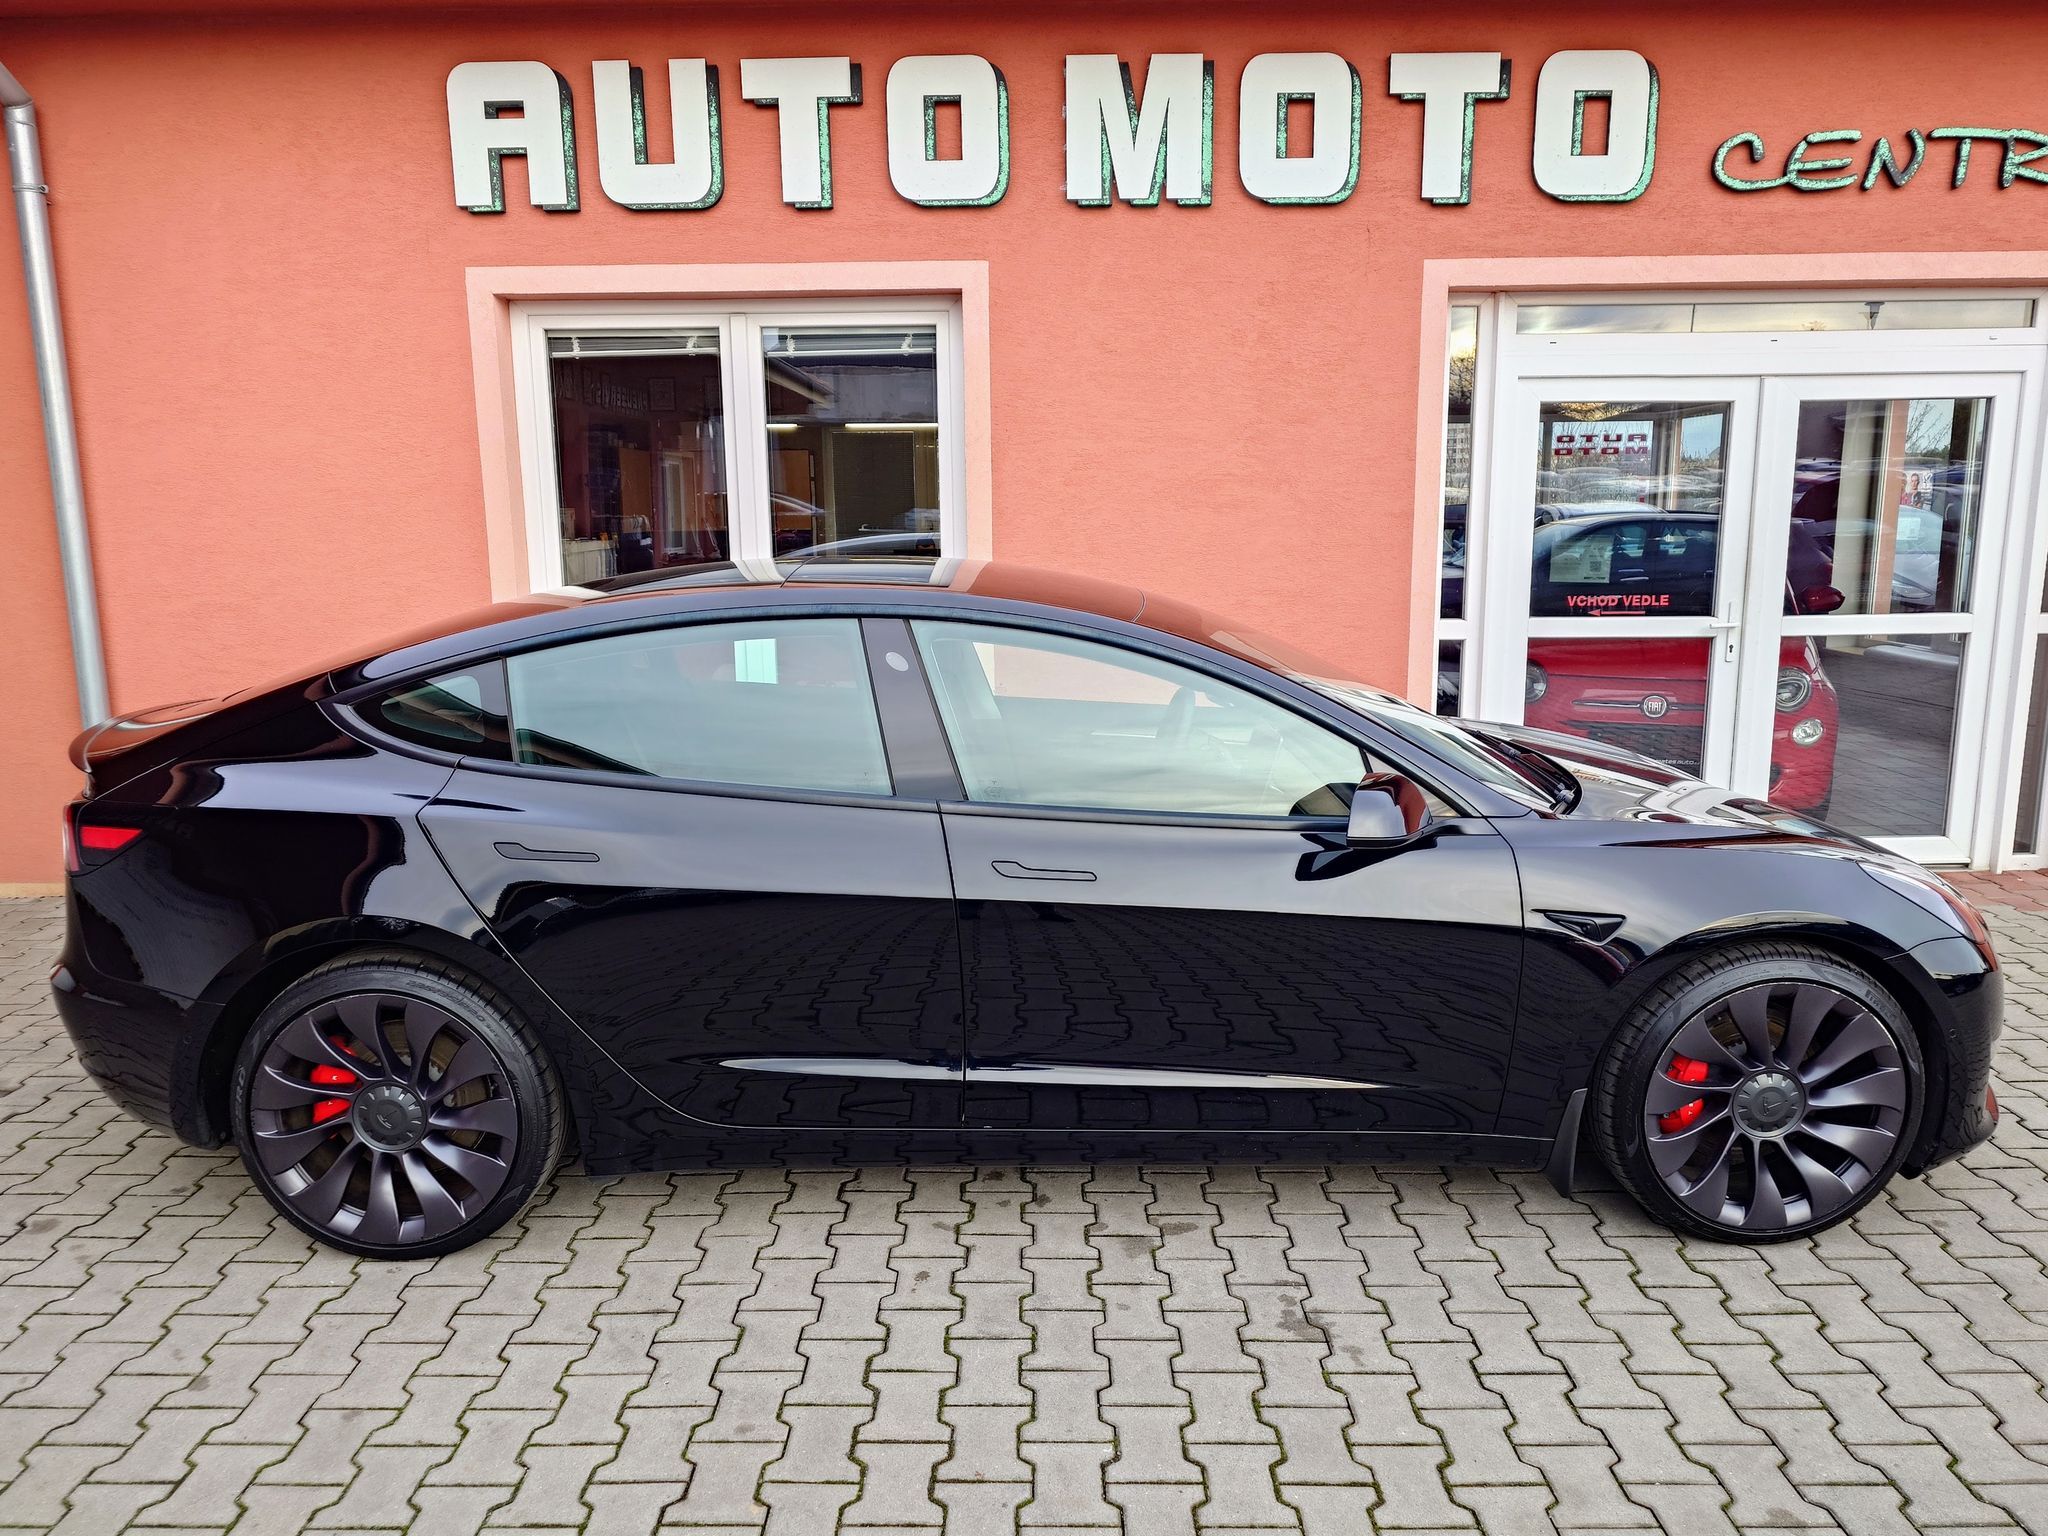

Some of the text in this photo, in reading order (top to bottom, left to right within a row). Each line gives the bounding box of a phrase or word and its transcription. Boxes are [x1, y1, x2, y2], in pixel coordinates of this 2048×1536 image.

[446, 50, 2048, 212] AUTO MOTO CENTR
[1568, 594, 1670, 607] VCHOD VEDLE
[1648, 701, 1662, 712] FIAT
